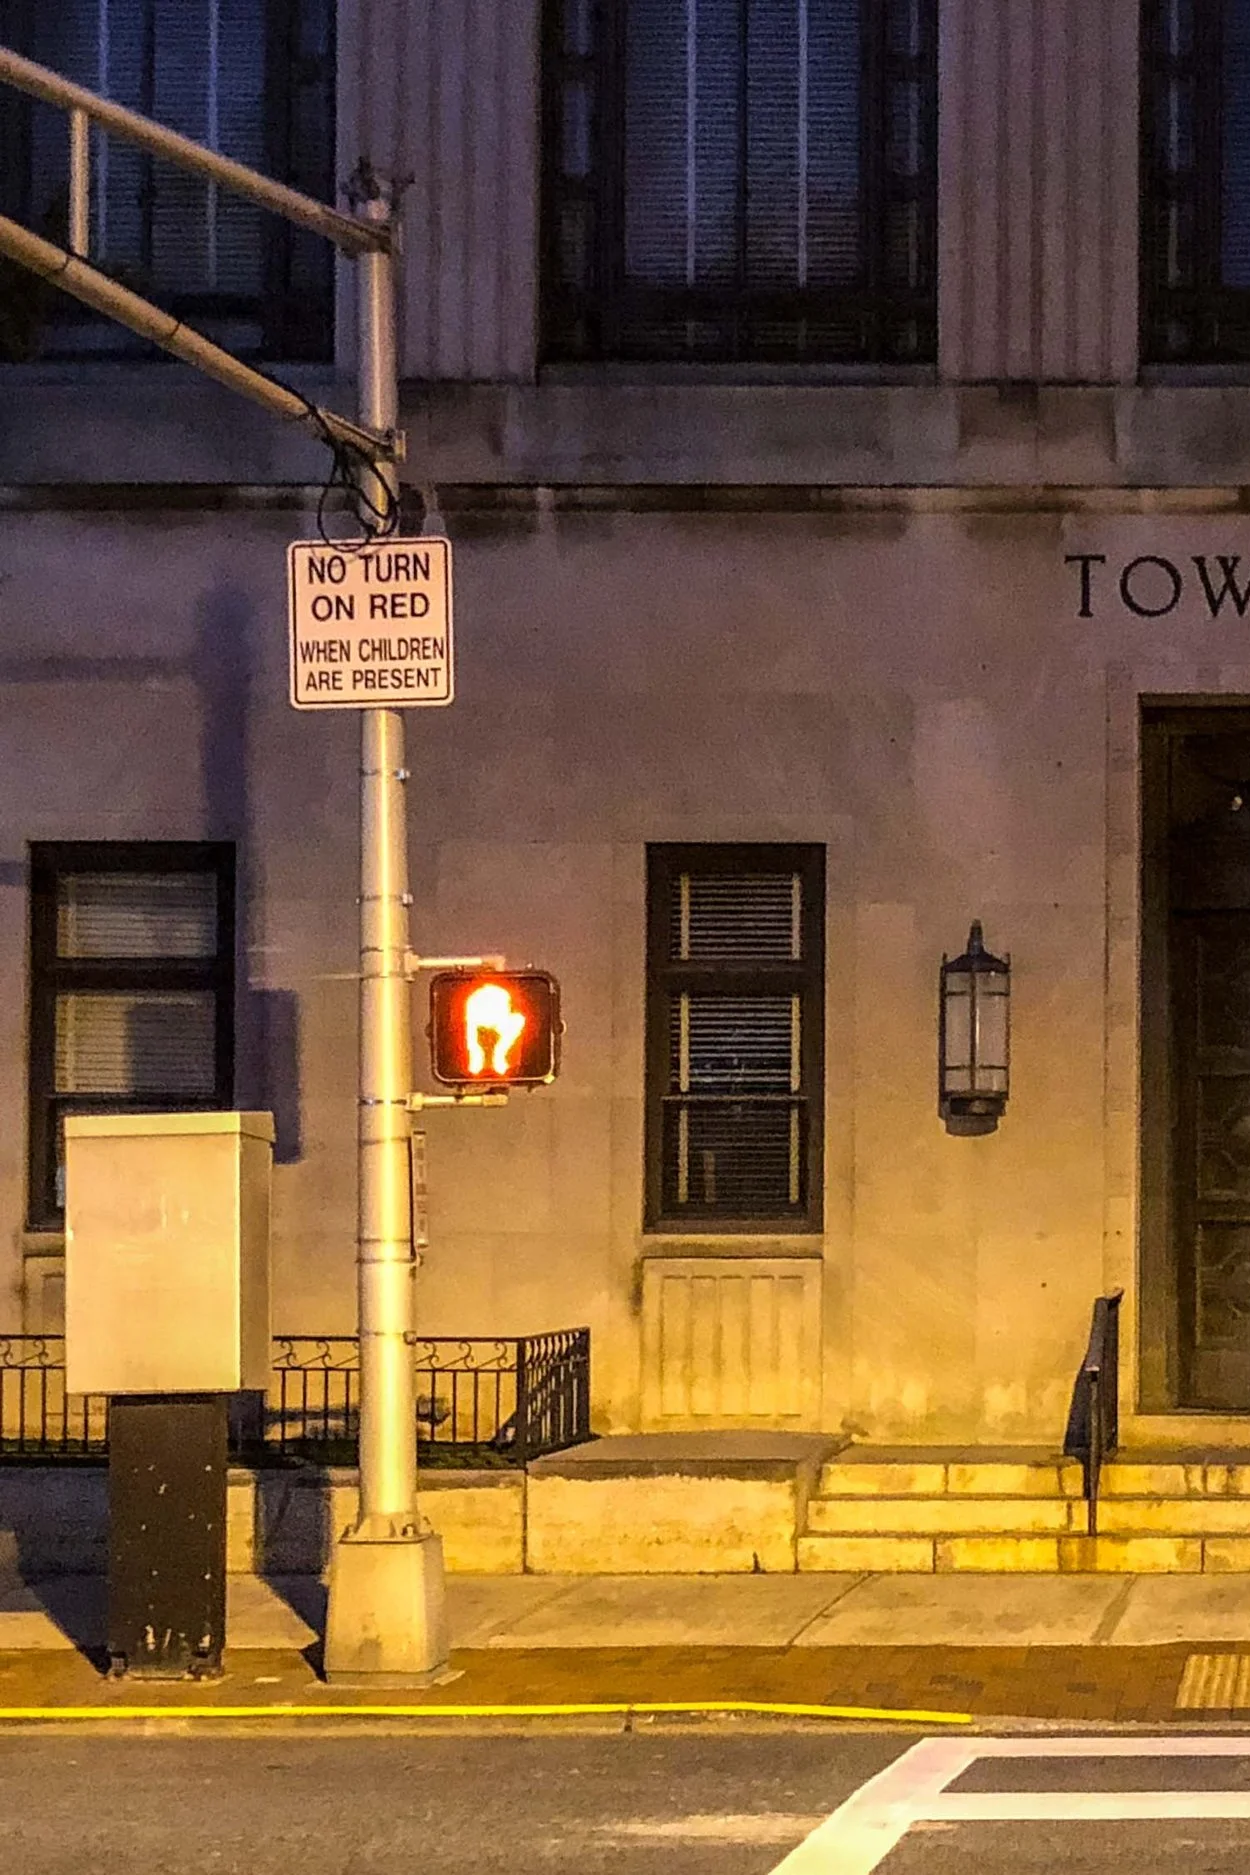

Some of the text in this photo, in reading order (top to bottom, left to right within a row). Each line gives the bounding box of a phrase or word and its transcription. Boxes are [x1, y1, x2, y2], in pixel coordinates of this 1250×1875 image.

[308, 552, 430, 584] NO TURN
[312, 592, 430, 622] ON RED
[300, 637, 444, 663] WHEN CHILDREN
[305, 667, 441, 691] ARE PRESENT
